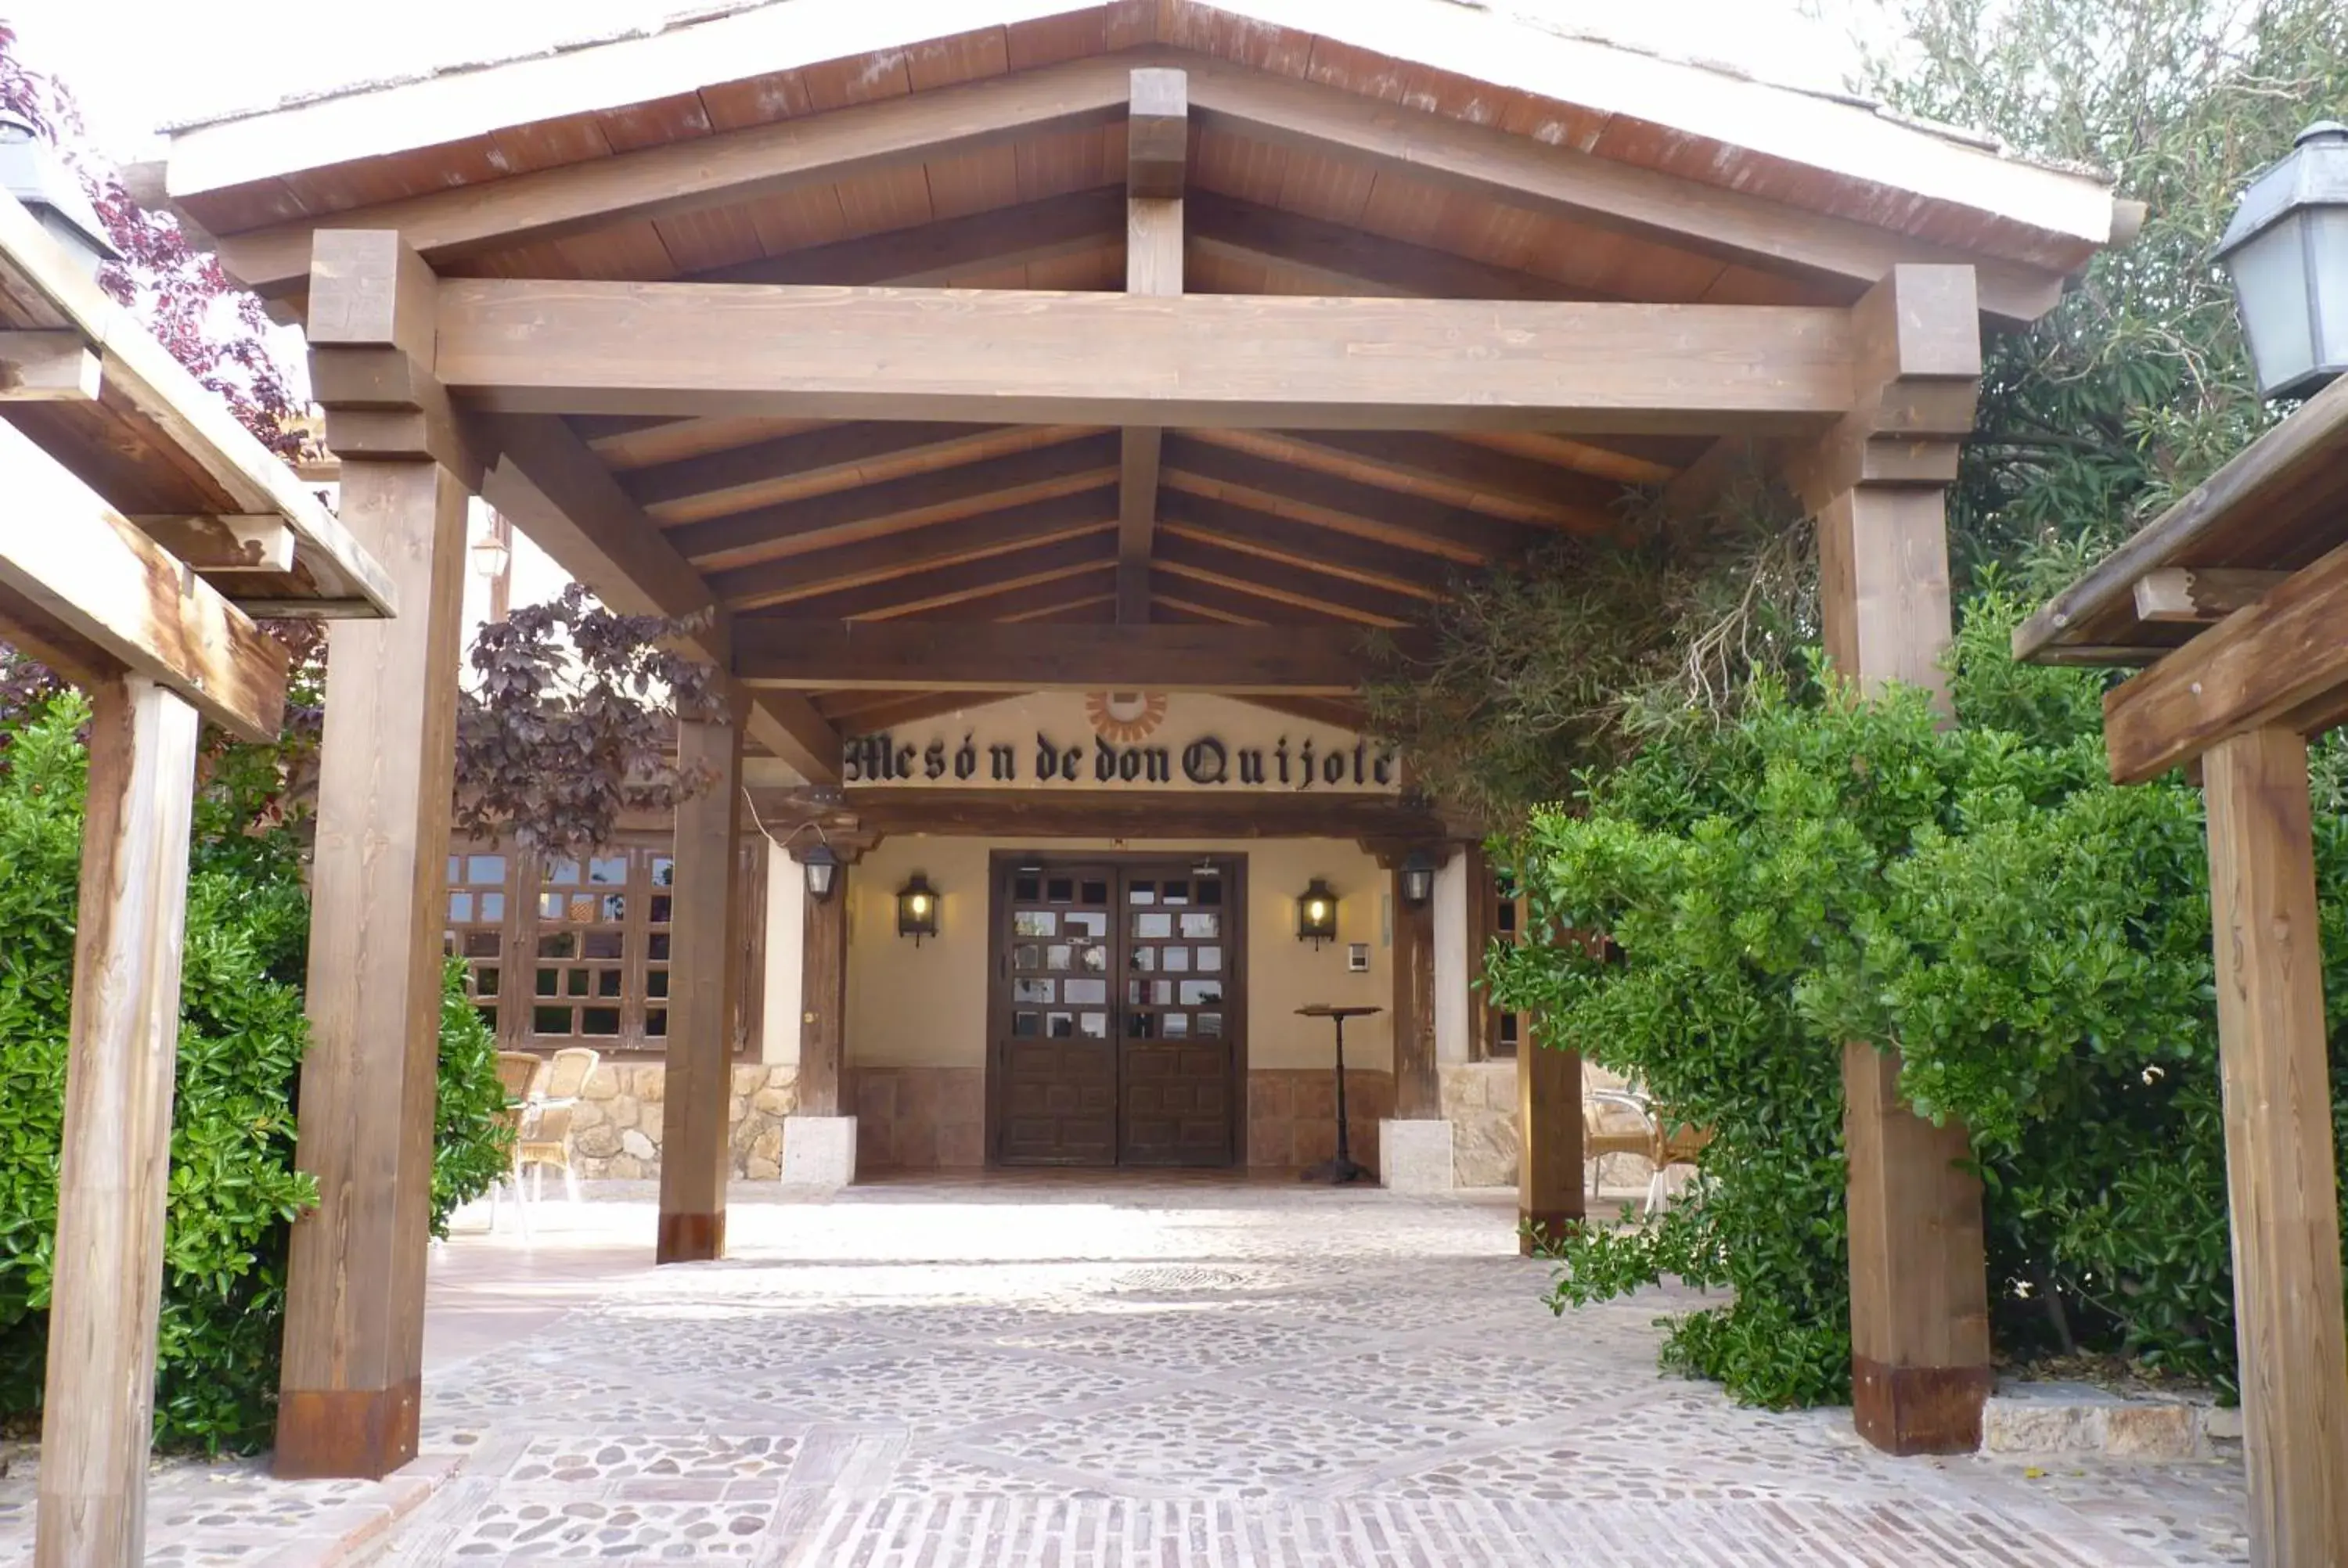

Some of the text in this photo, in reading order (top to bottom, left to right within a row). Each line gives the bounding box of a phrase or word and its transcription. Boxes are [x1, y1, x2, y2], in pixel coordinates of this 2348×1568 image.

[844, 726, 1392, 792] Mesón de don Quijote
